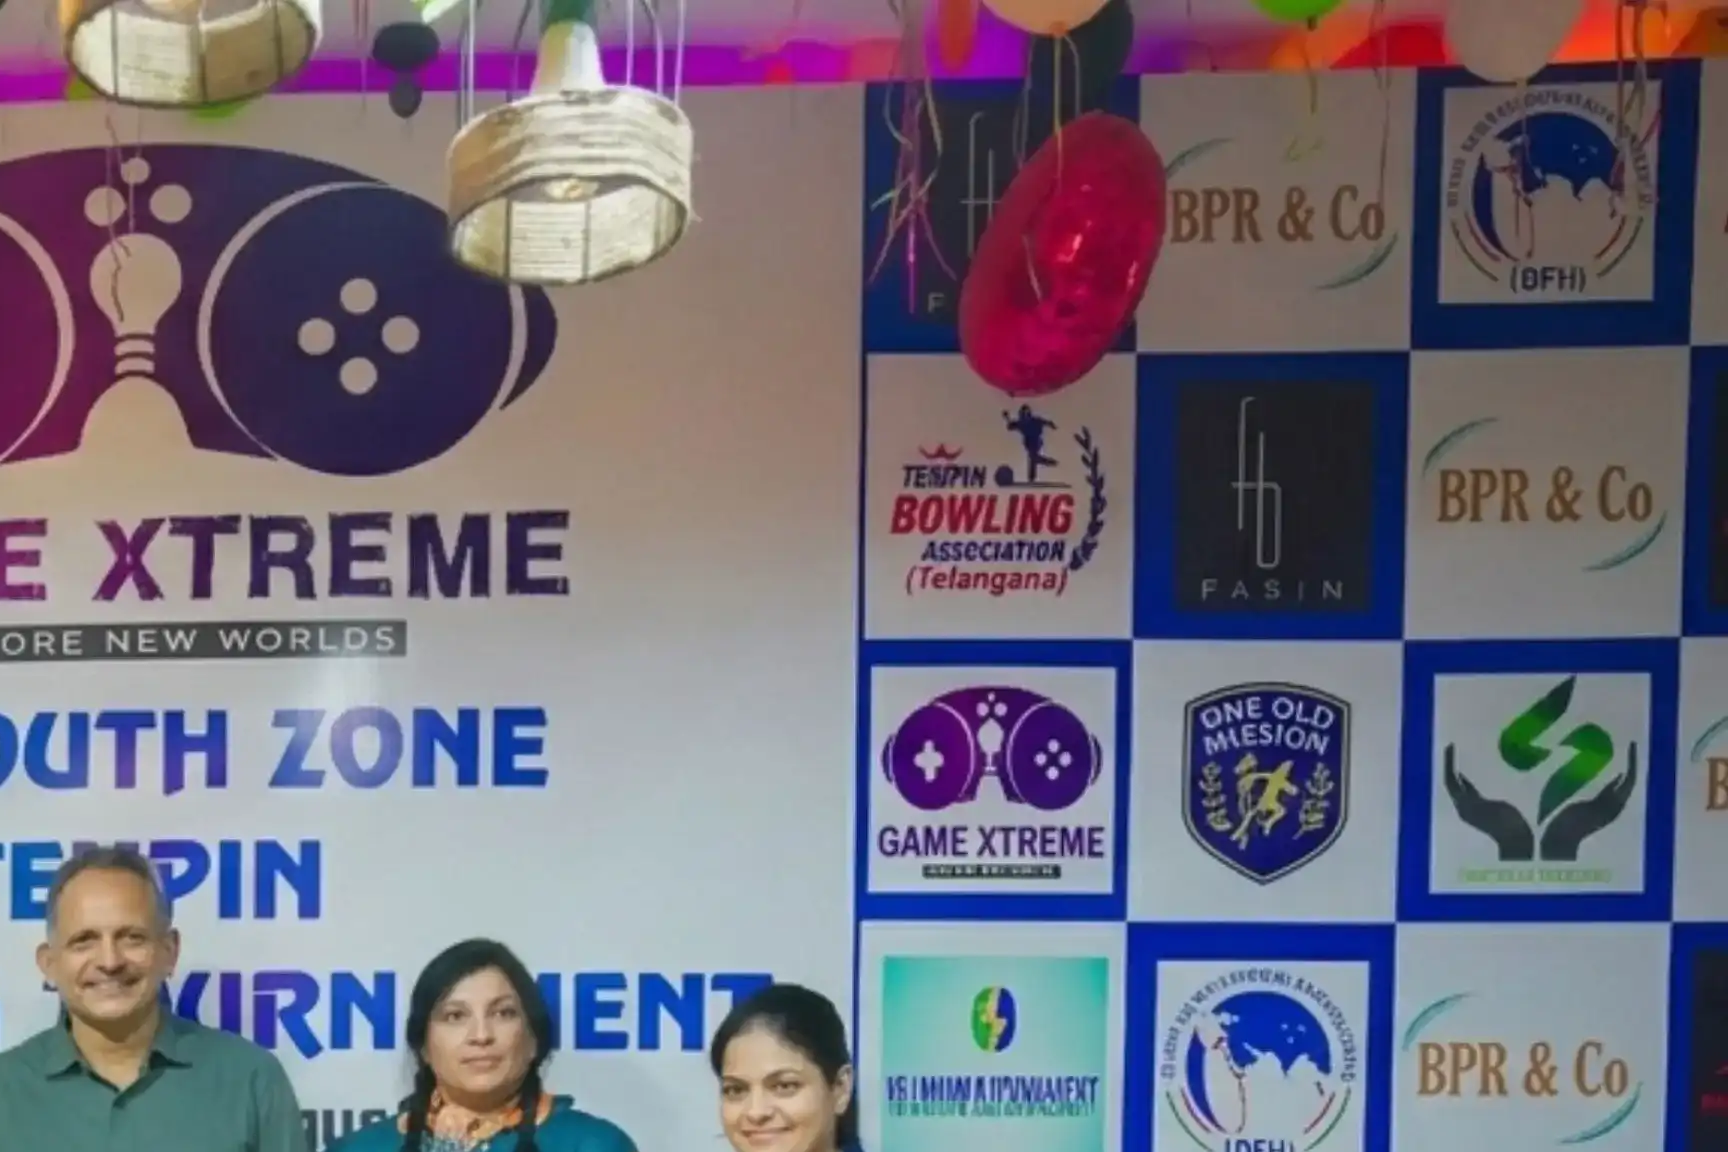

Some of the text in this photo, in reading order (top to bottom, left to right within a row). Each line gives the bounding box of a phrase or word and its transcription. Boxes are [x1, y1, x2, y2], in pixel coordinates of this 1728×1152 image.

[1169, 184, 1385, 245] BPR & Co
[890, 494, 1076, 535] BOWLING
[1437, 466, 1653, 524] BPR & Co
[92, 510, 570, 602] XTREME
[906, 566, 1068, 597] (Telangana)
[1201, 579, 1343, 601] FASIN
[104, 627, 198, 655] NEW
[219, 624, 396, 655] WORLDS
[1199, 697, 1335, 730] ONE OLD
[268, 706, 549, 791] ZONE
[879, 826, 1105, 859] GAME XTREME
[1418, 1040, 1628, 1098] BPR & Co
